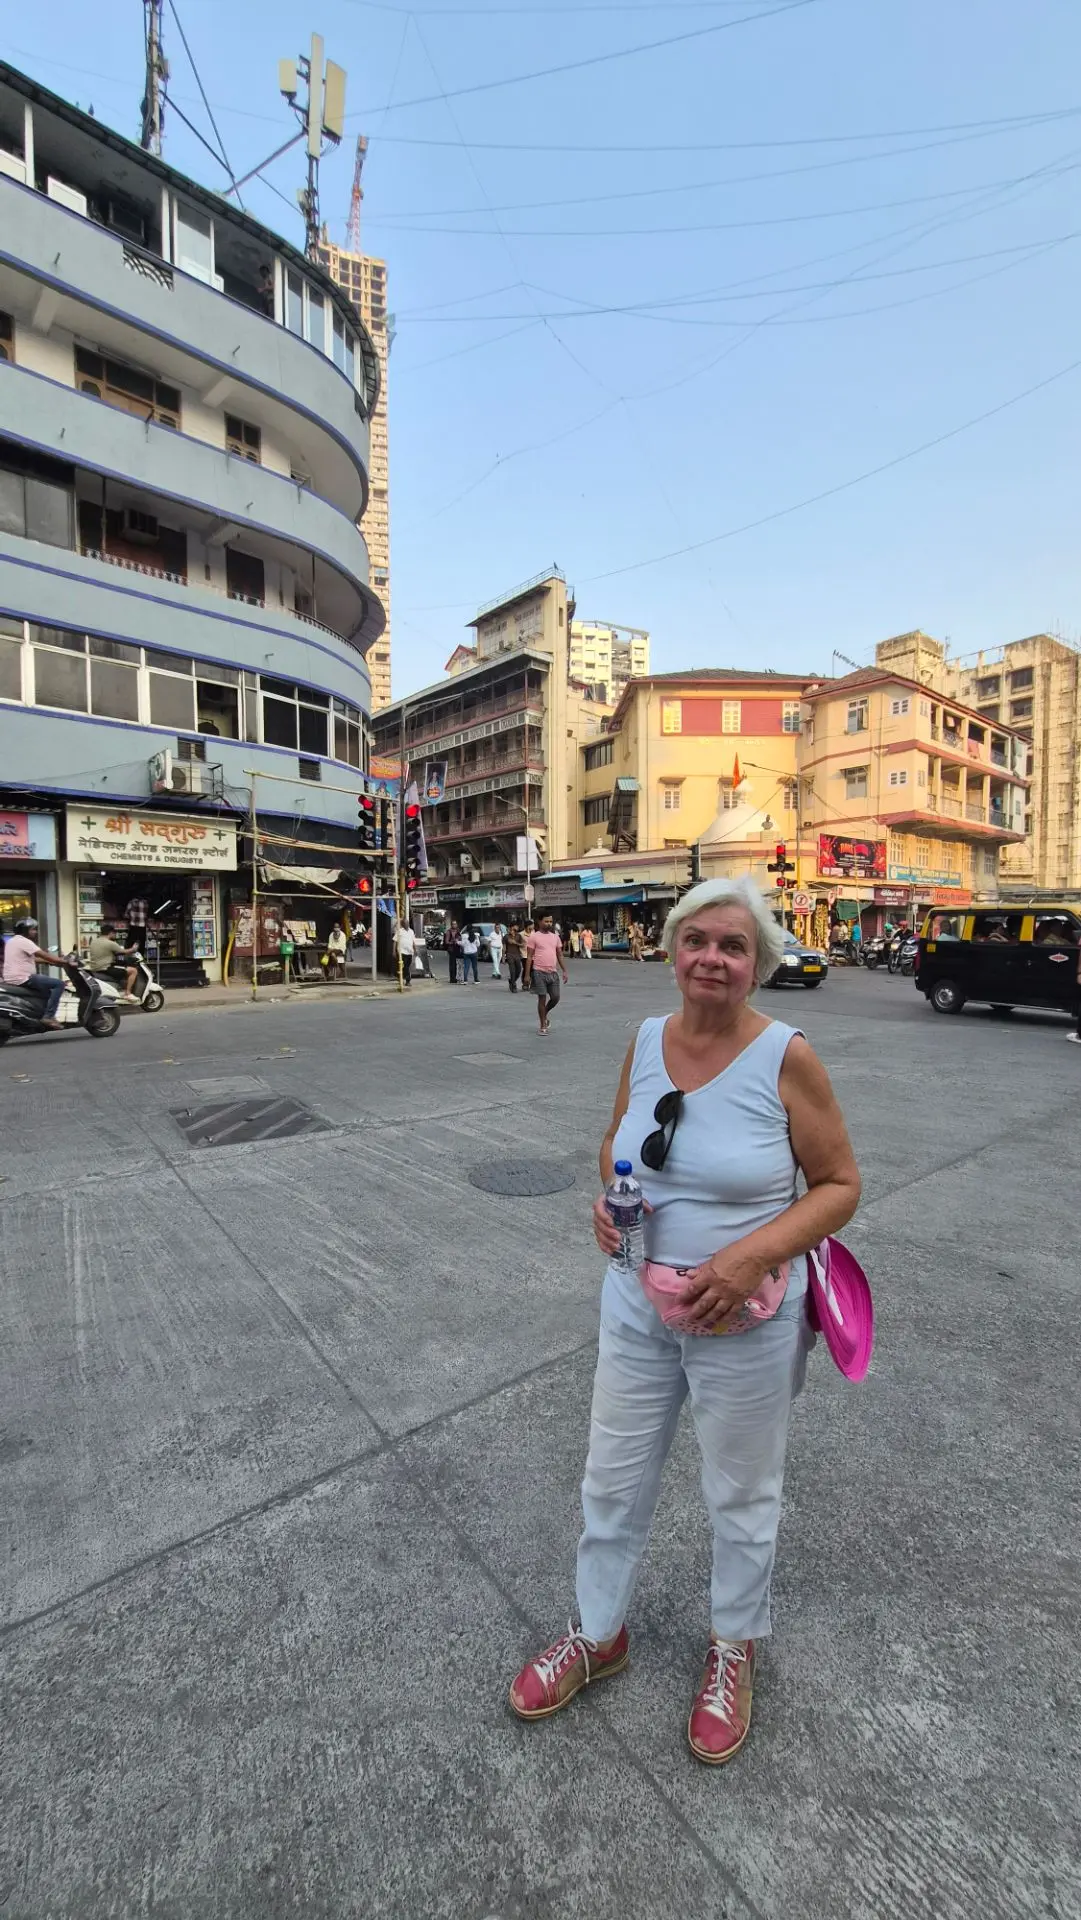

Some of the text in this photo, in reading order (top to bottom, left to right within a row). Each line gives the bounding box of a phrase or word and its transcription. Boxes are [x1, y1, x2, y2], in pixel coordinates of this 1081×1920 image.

[104, 812, 133, 835] श्री
[78, 836, 127, 851] मेडिकल
[161, 844, 199, 856] जनरल
[110, 852, 153, 862] CHEMISTS
